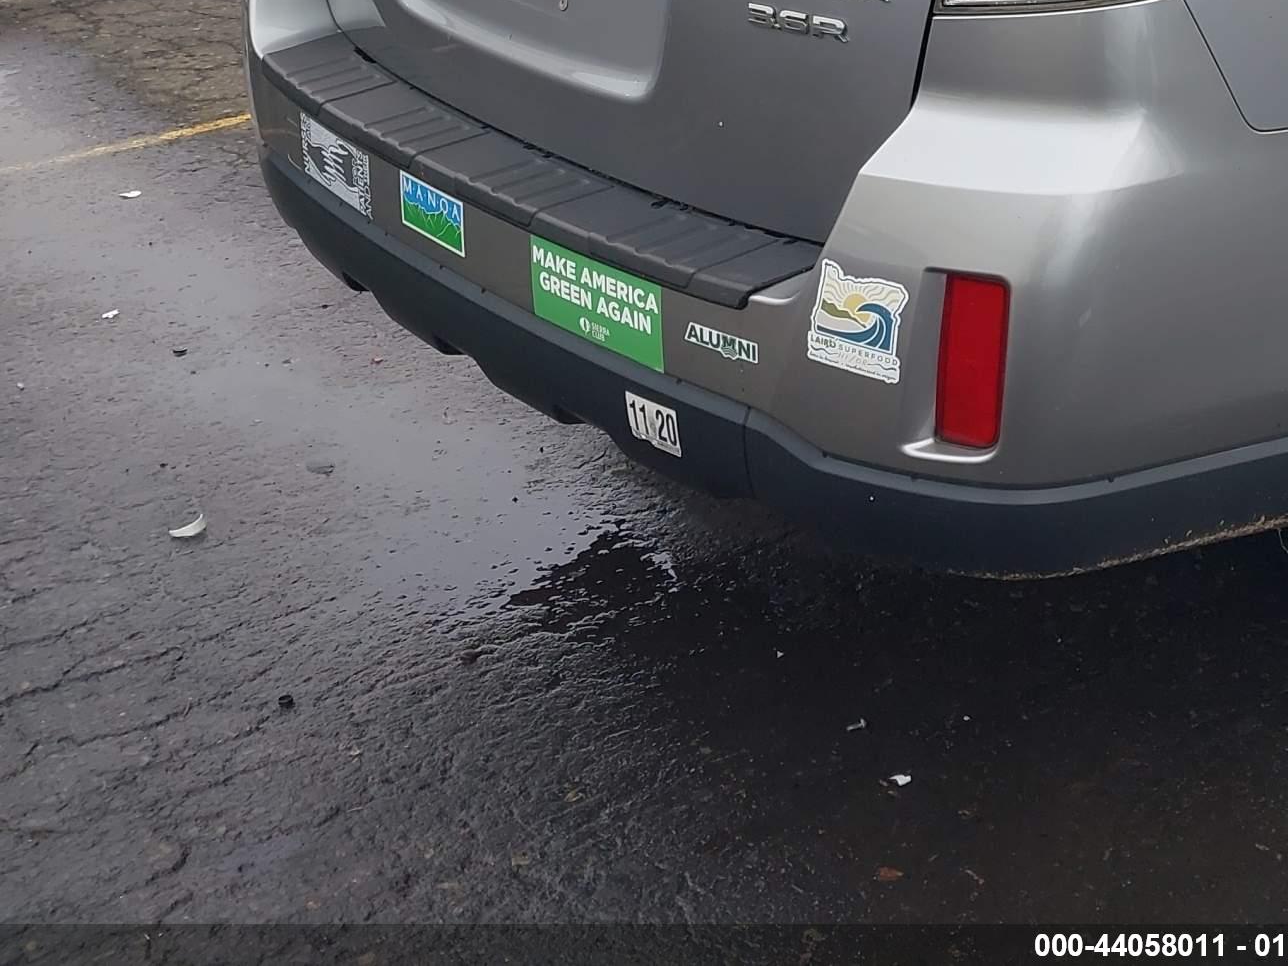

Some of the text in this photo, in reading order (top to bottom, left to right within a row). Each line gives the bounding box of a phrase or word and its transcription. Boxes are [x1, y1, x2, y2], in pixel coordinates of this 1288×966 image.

[748, 2, 849, 43] 3.6R
[532, 245, 659, 314] MAKE AMERICA
[540, 271, 652, 335] GREEN AGAIN
[687, 324, 757, 362] ALUMNI
[810, 334, 837, 348] LAIRD
[838, 344, 898, 366] SUPERFOOD
[629, 400, 678, 447] 11 20
